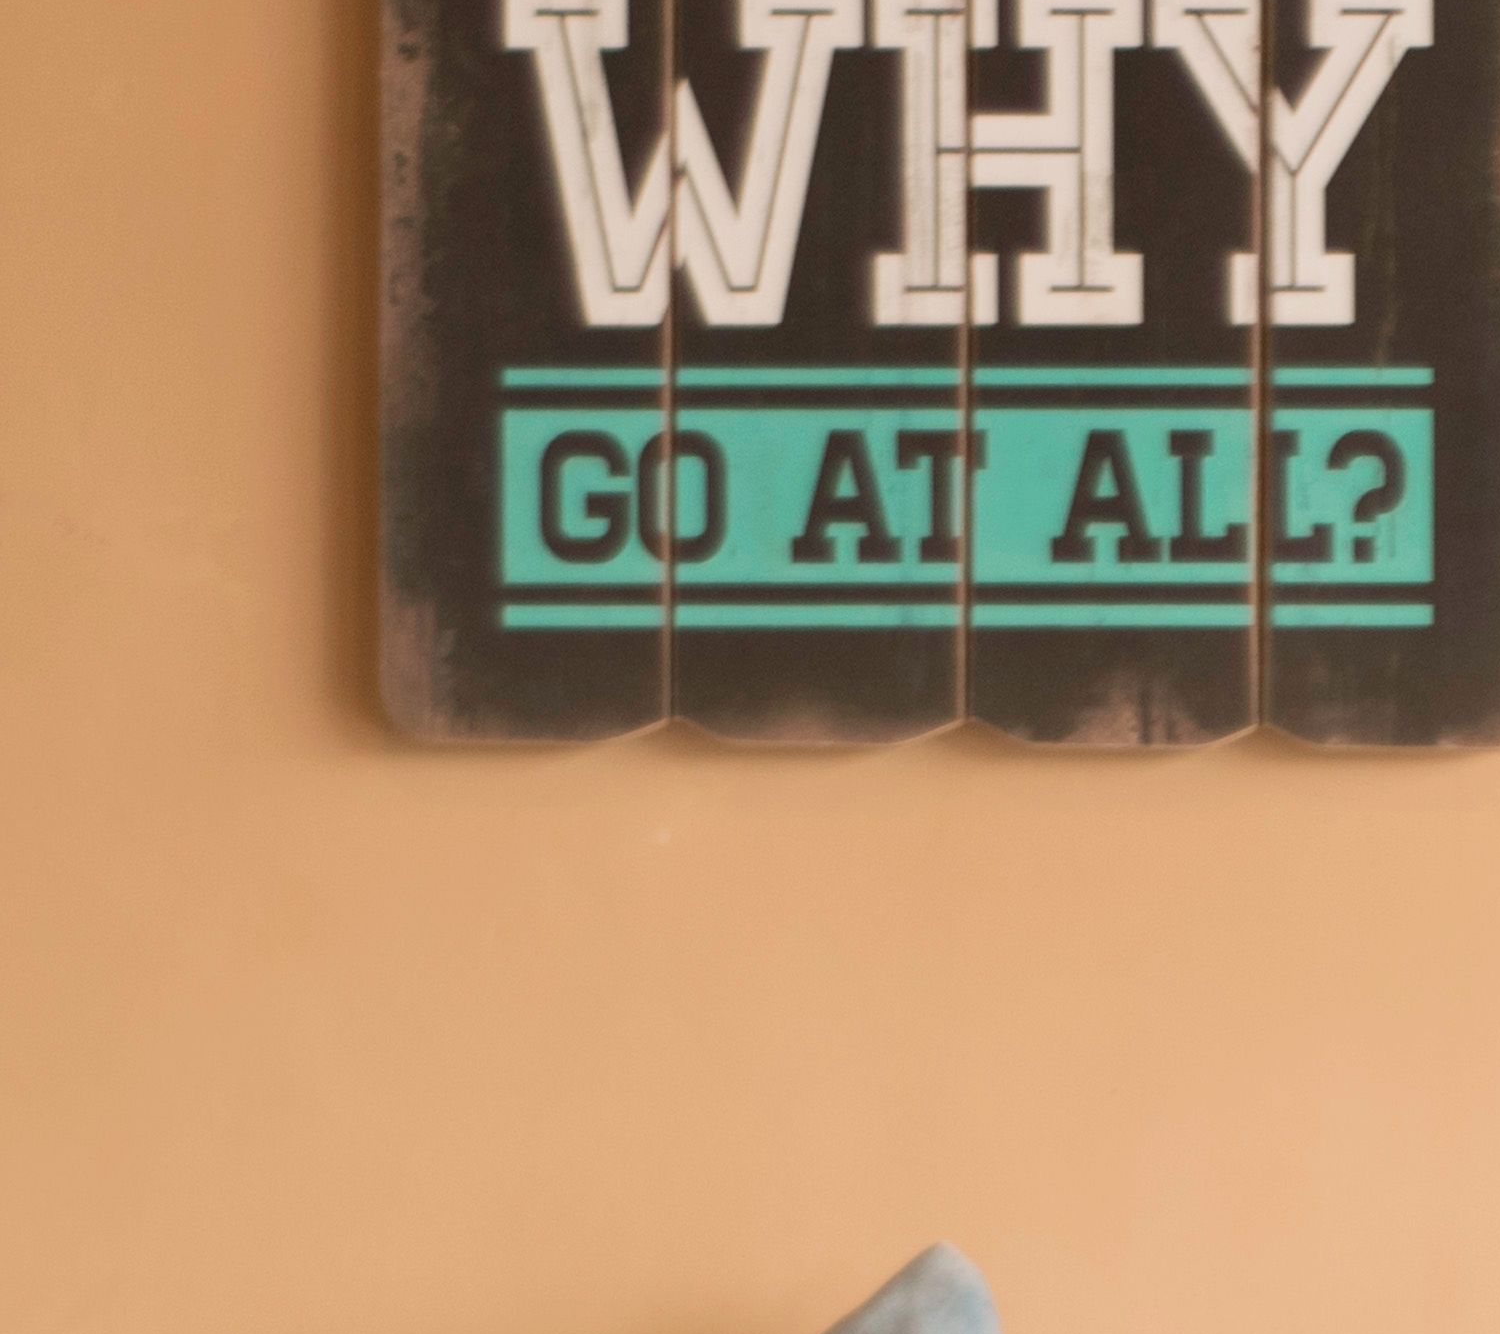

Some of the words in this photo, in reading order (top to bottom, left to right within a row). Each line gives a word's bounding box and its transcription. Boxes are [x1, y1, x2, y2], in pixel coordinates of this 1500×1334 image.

[536, 430, 731, 567] GO
[788, 430, 986, 567] AT
[1048, 430, 1408, 567] ALL?
